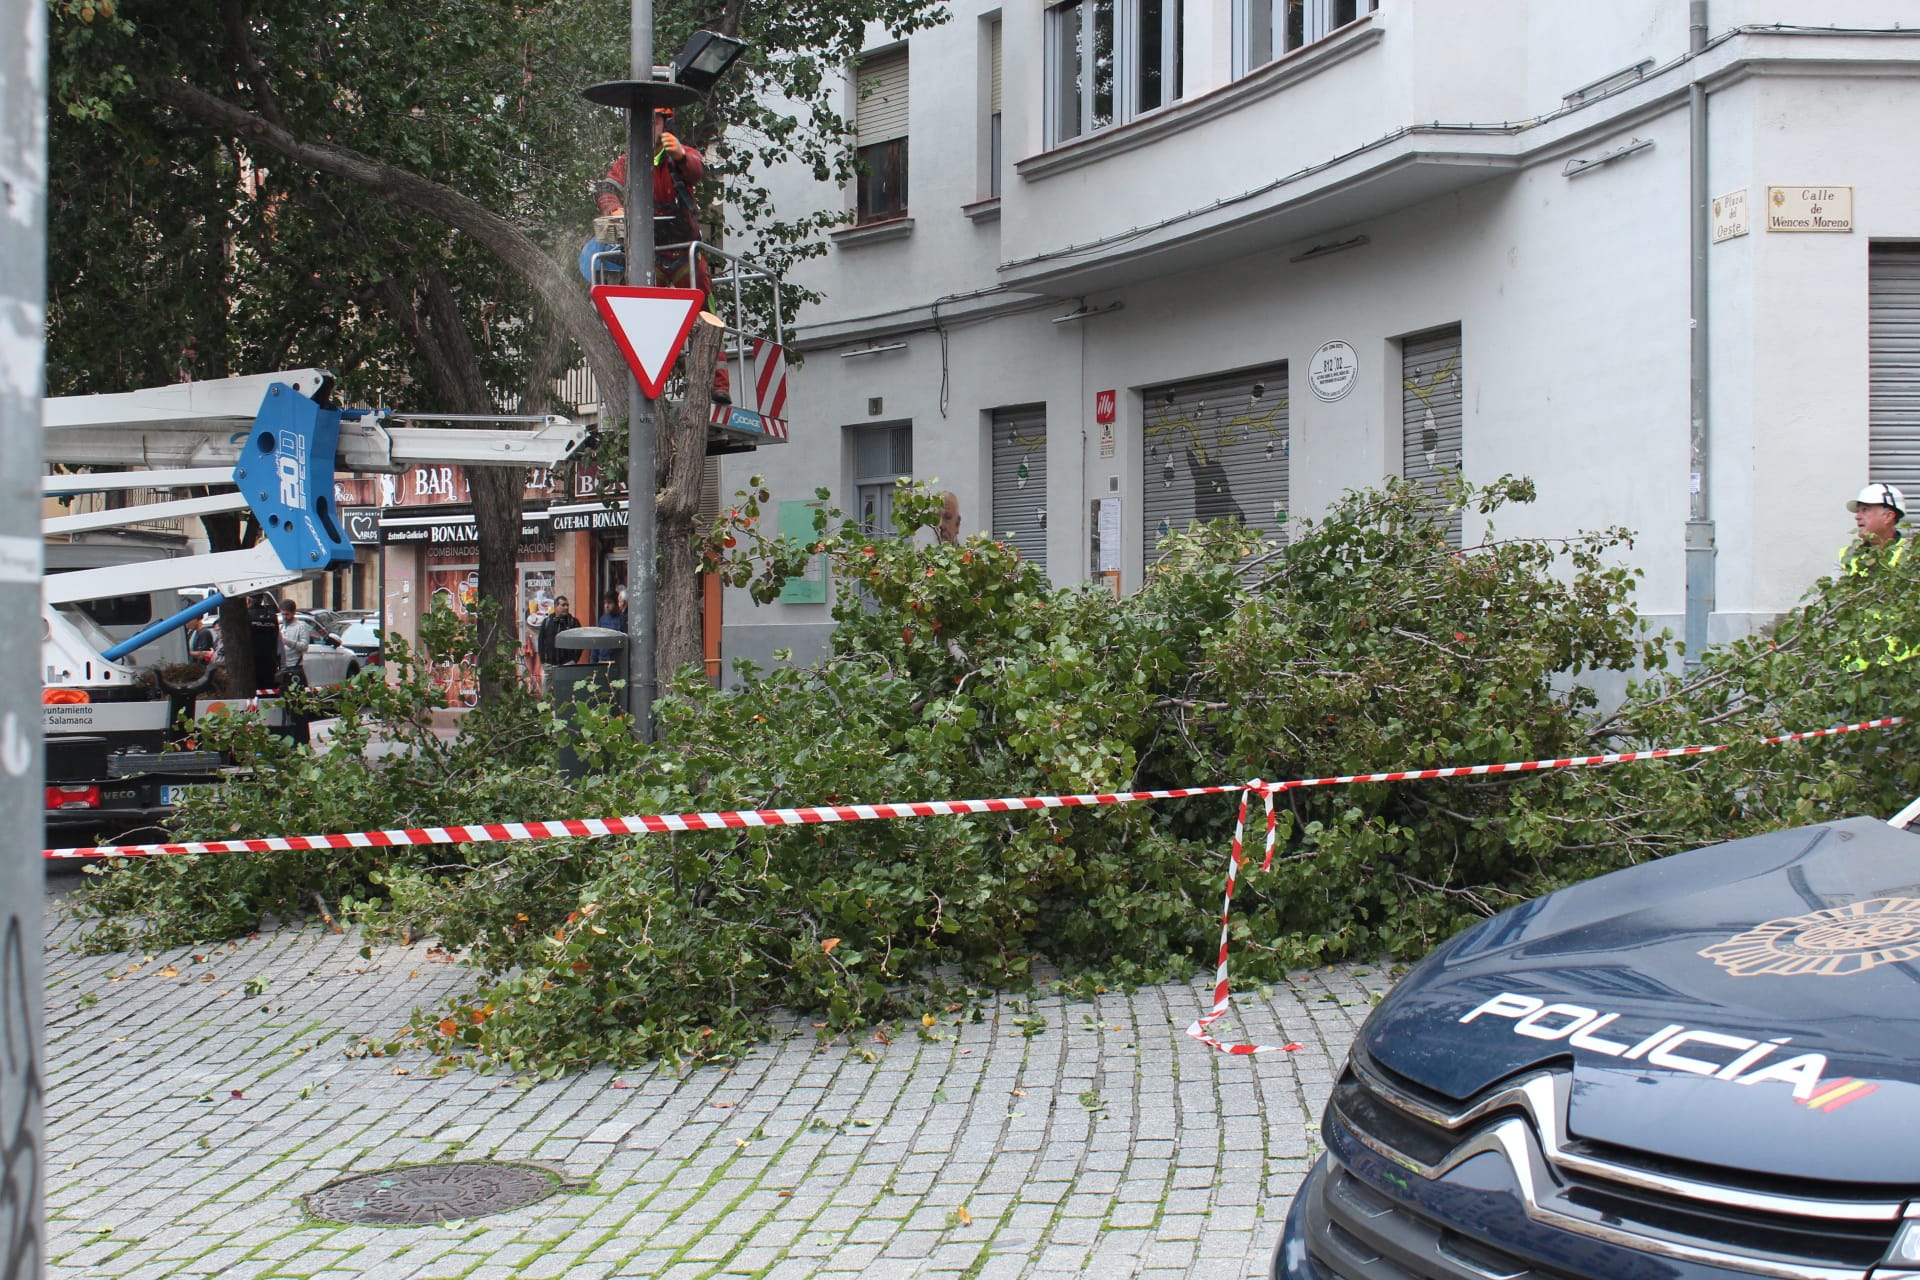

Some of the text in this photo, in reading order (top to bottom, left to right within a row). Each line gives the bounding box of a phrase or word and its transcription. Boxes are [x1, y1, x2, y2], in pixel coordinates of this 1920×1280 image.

[1802, 189, 1835, 202] Calle
[1724, 196, 1744, 209] Plaza
[1810, 202, 1823, 215] de
[1728, 208, 1738, 220] del
[1772, 216, 1850, 229] Wences Moreno
[1717, 223, 1743, 238] Oeste
[1097, 394, 1114, 419] illy
[415, 467, 457, 502] BAR
[592, 511, 629, 528] BONANZ
[518, 542, 555, 554] RACIONE
[42, 706, 93, 717] yuntamiento
[49, 716, 93, 726] Salamanca
[1458, 992, 1827, 1100] POLICÍA
